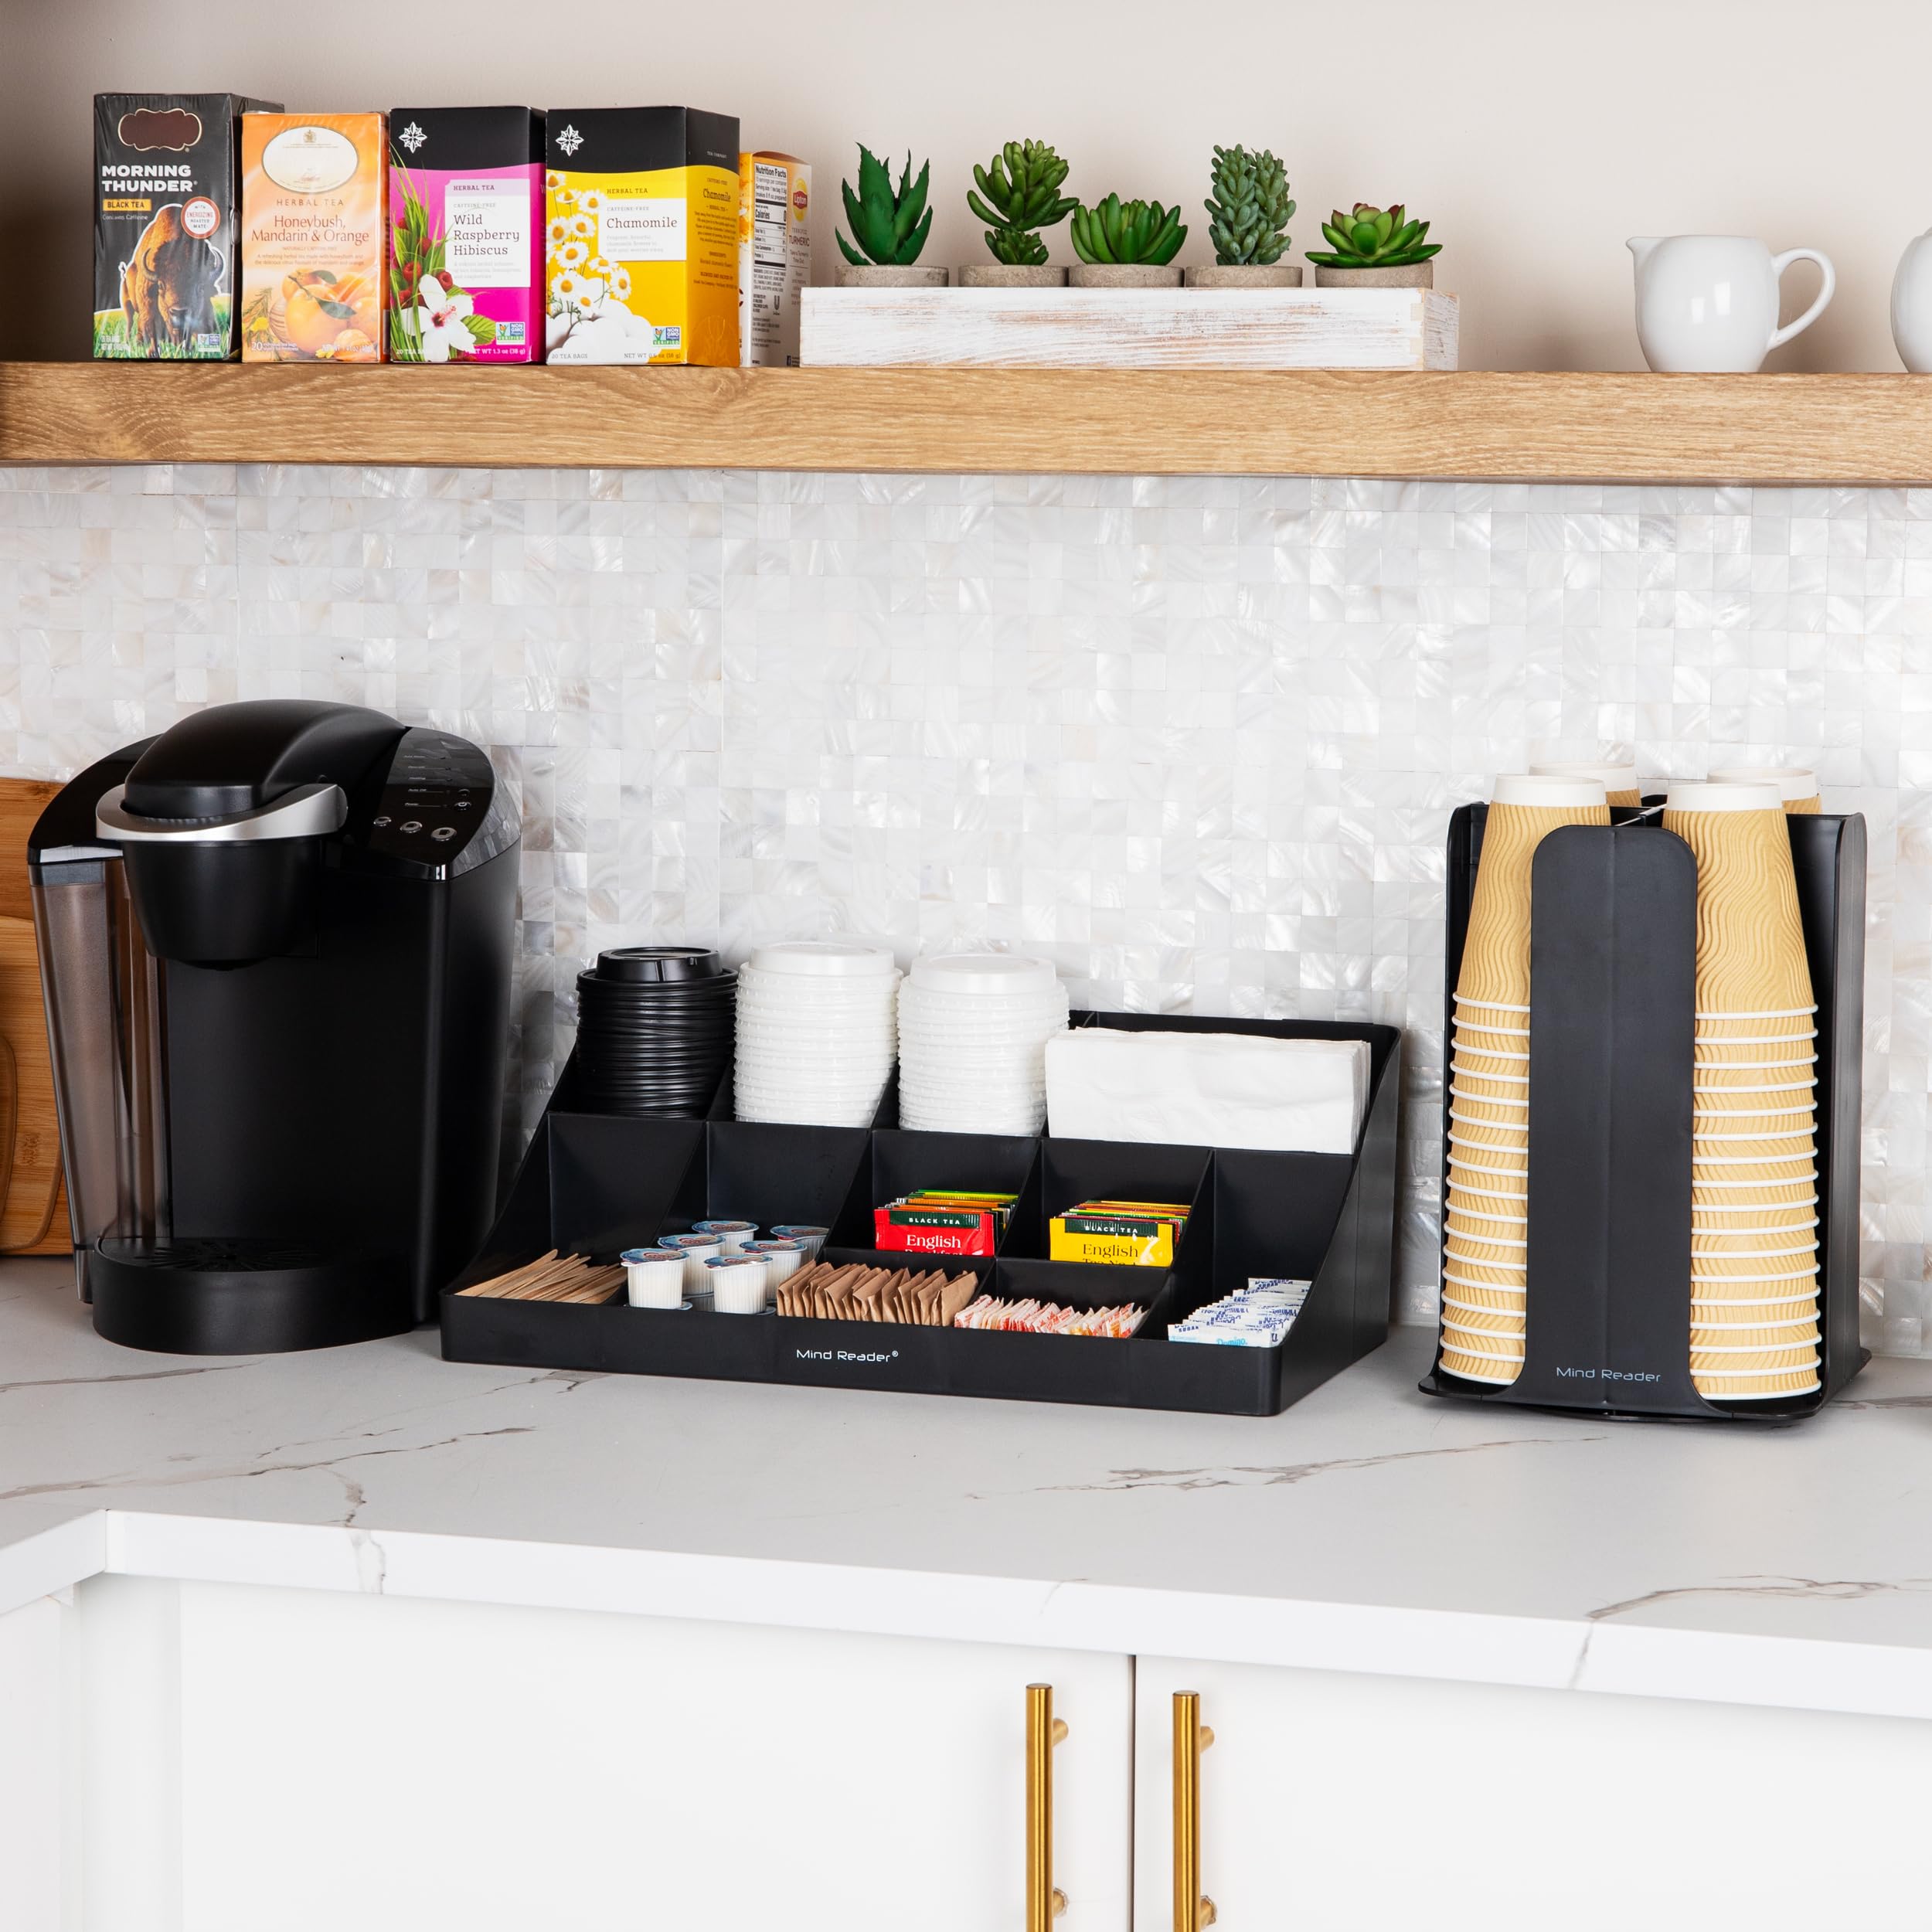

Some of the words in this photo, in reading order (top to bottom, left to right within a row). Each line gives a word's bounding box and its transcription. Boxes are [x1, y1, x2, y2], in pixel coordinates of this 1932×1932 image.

[102, 165, 192, 177] MORNING
[755, 165, 774, 176] Nutrition
[775, 168, 787, 179] Facts
[107, 199, 129, 208] BLACK
[131, 199, 145, 208] TEA
[794, 194, 807, 205] Lipton
[454, 214, 482, 225] Wild
[755, 209, 770, 220] Calories
[274, 214, 346, 232] Honeybush,
[607, 216, 678, 228] Chamomile
[251, 229, 308, 242] Mandarin
[311, 230, 320, 242] &
[324, 230, 369, 246] Orange
[454, 229, 519, 242] Raspberry
[789, 235, 810, 247] TURMERIC
[454, 244, 508, 255] Hibiscus
[251, 342, 264, 351] 20
[906, 1234, 961, 1250] English
[1083, 1243, 1138, 1259] English
[796, 1349, 832, 1360] Mind
[1556, 1366, 1595, 1378] Mind
[1601, 1369, 1661, 1382] Reader
